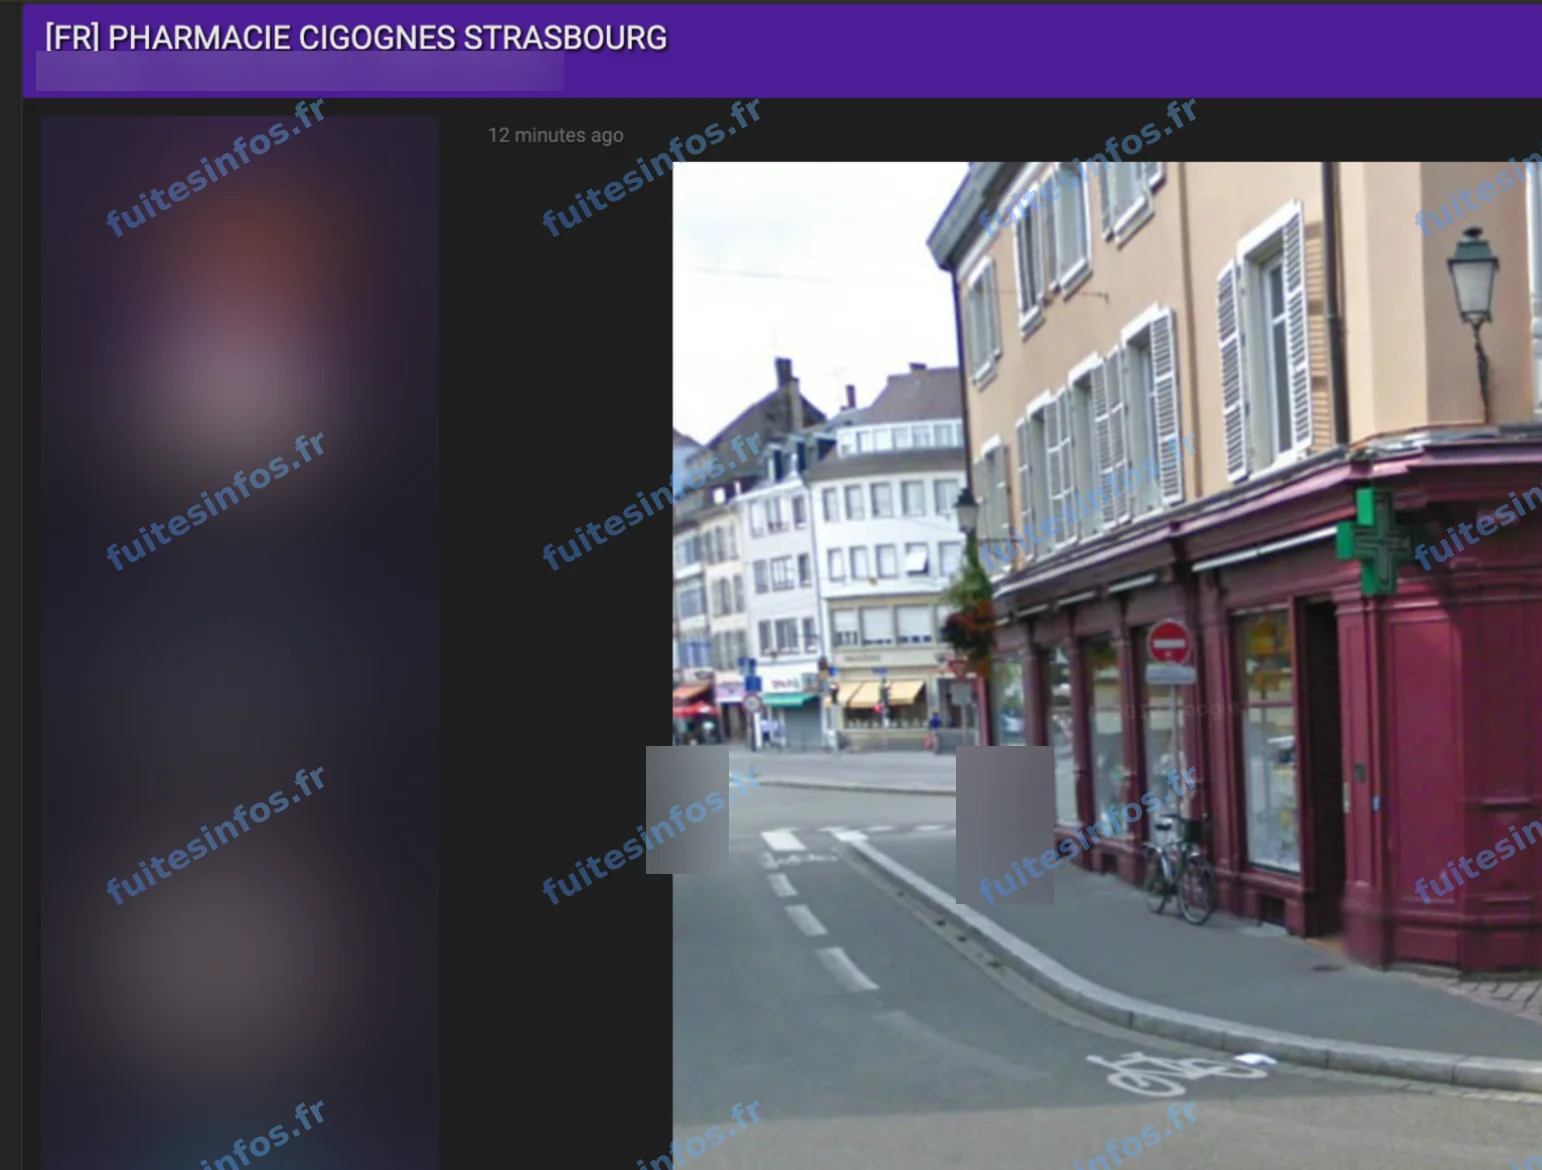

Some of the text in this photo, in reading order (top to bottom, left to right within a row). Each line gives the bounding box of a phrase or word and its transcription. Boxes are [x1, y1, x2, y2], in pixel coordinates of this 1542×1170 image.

[45, 20, 668, 53] [FR] PHARMACIE CIGOGNES STRASBOURG
[488, 126, 625, 148] 12 minutes ago
